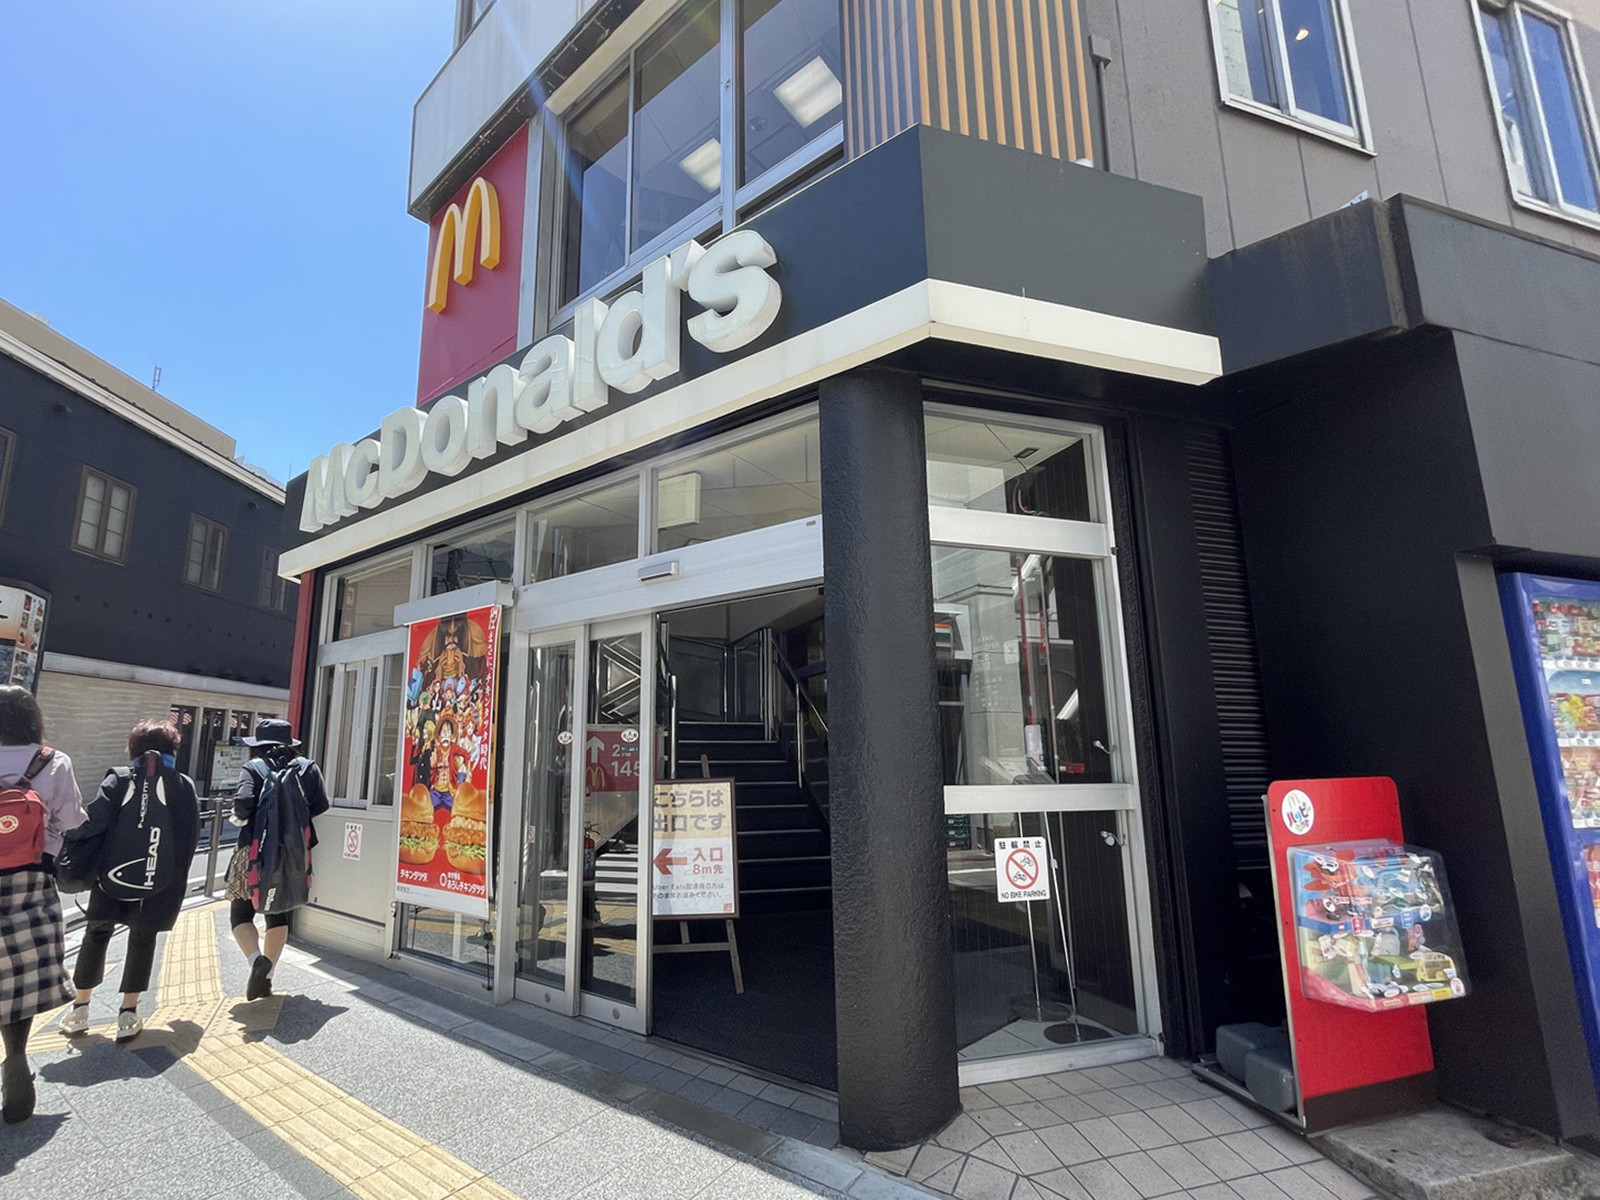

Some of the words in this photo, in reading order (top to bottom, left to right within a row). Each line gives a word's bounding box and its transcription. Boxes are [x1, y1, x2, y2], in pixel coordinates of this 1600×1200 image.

[299, 229, 782, 533] McDonald's
[653, 789, 724, 808] こちらは
[653, 812, 727, 832] 出口です
[144, 826, 161, 886] HEAD
[692, 847, 724, 862] 入口
[400, 869, 428, 882] チキンタツタ
[692, 864, 724, 875] 8m先
[1001, 891, 1009, 899] NO
[1010, 890, 1022, 898] BIKE
[1023, 889, 1047, 898] PARKING
